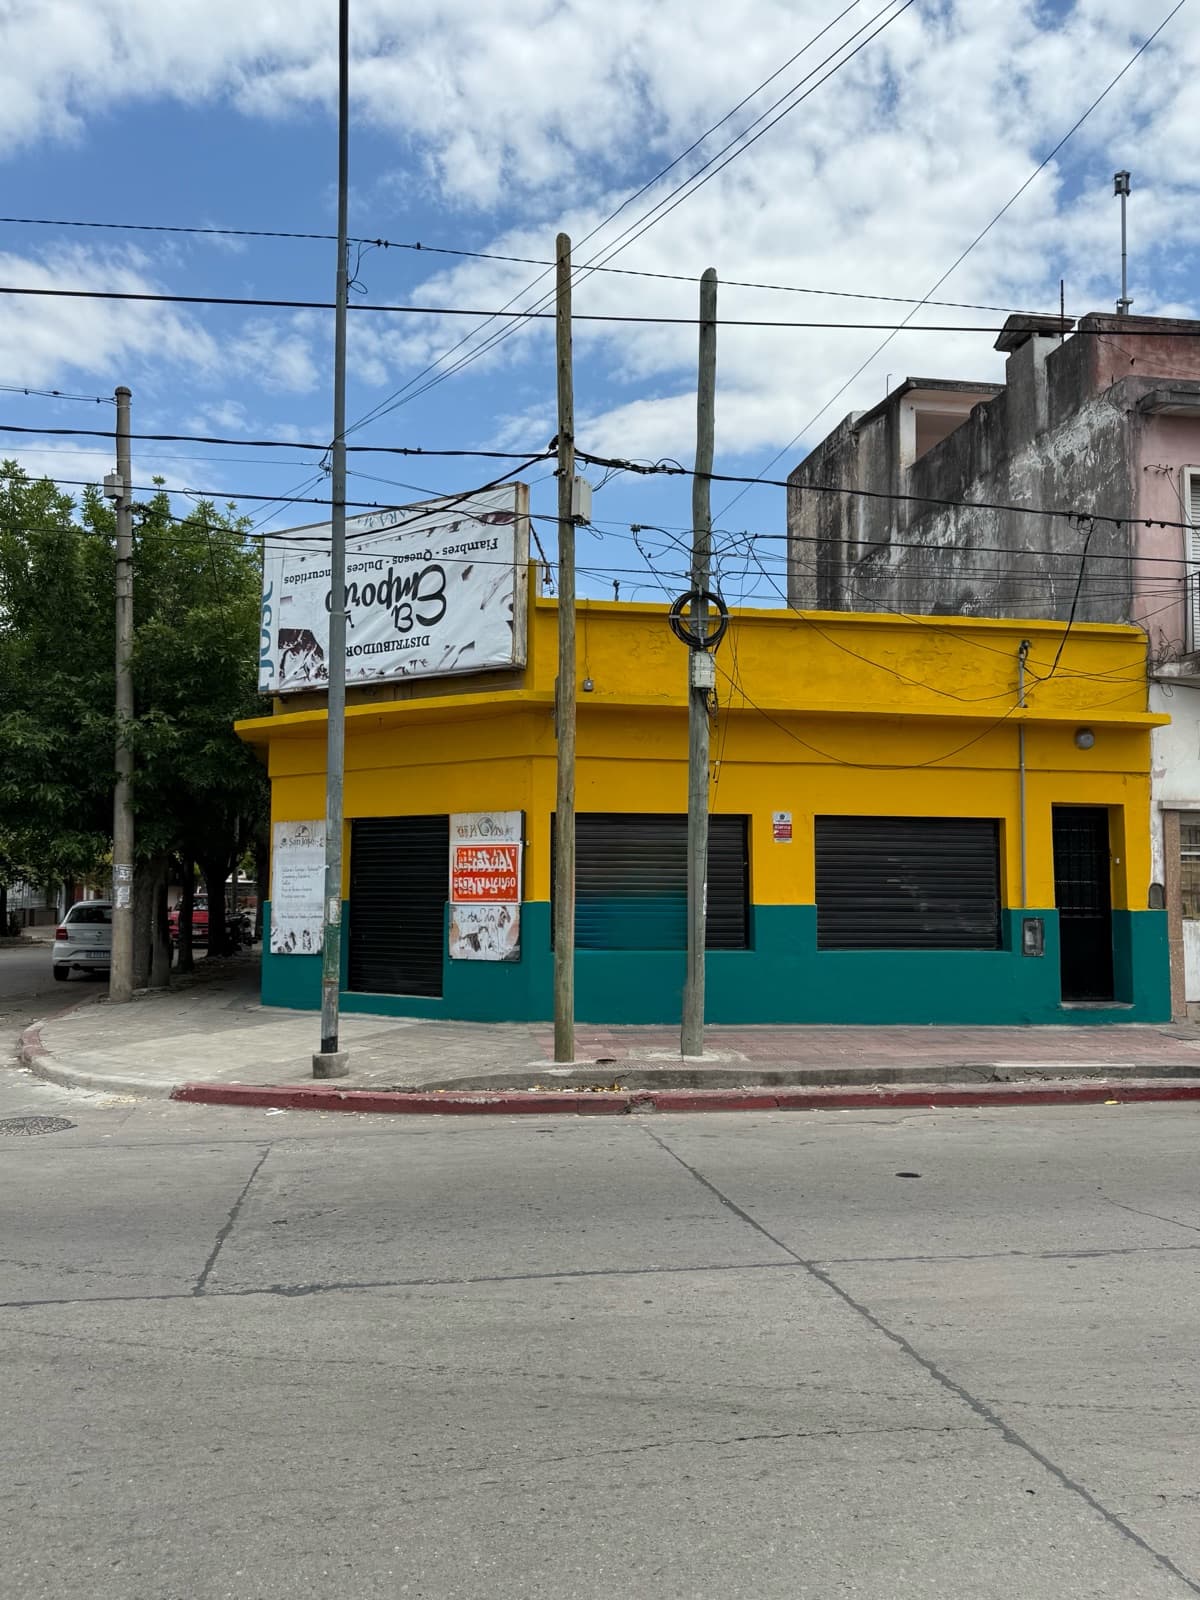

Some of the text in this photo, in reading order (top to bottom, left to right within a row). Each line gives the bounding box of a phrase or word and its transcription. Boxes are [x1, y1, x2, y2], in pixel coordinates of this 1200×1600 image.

[443, 538, 499, 555] Fiambres
[392, 549, 433, 565] Quesos
[347, 559, 384, 574] Dulces
[284, 569, 332, 585] ncurtidos
[390, 602, 414, 633] El
[345, 635, 431, 658] DISTRIBUIDOR
